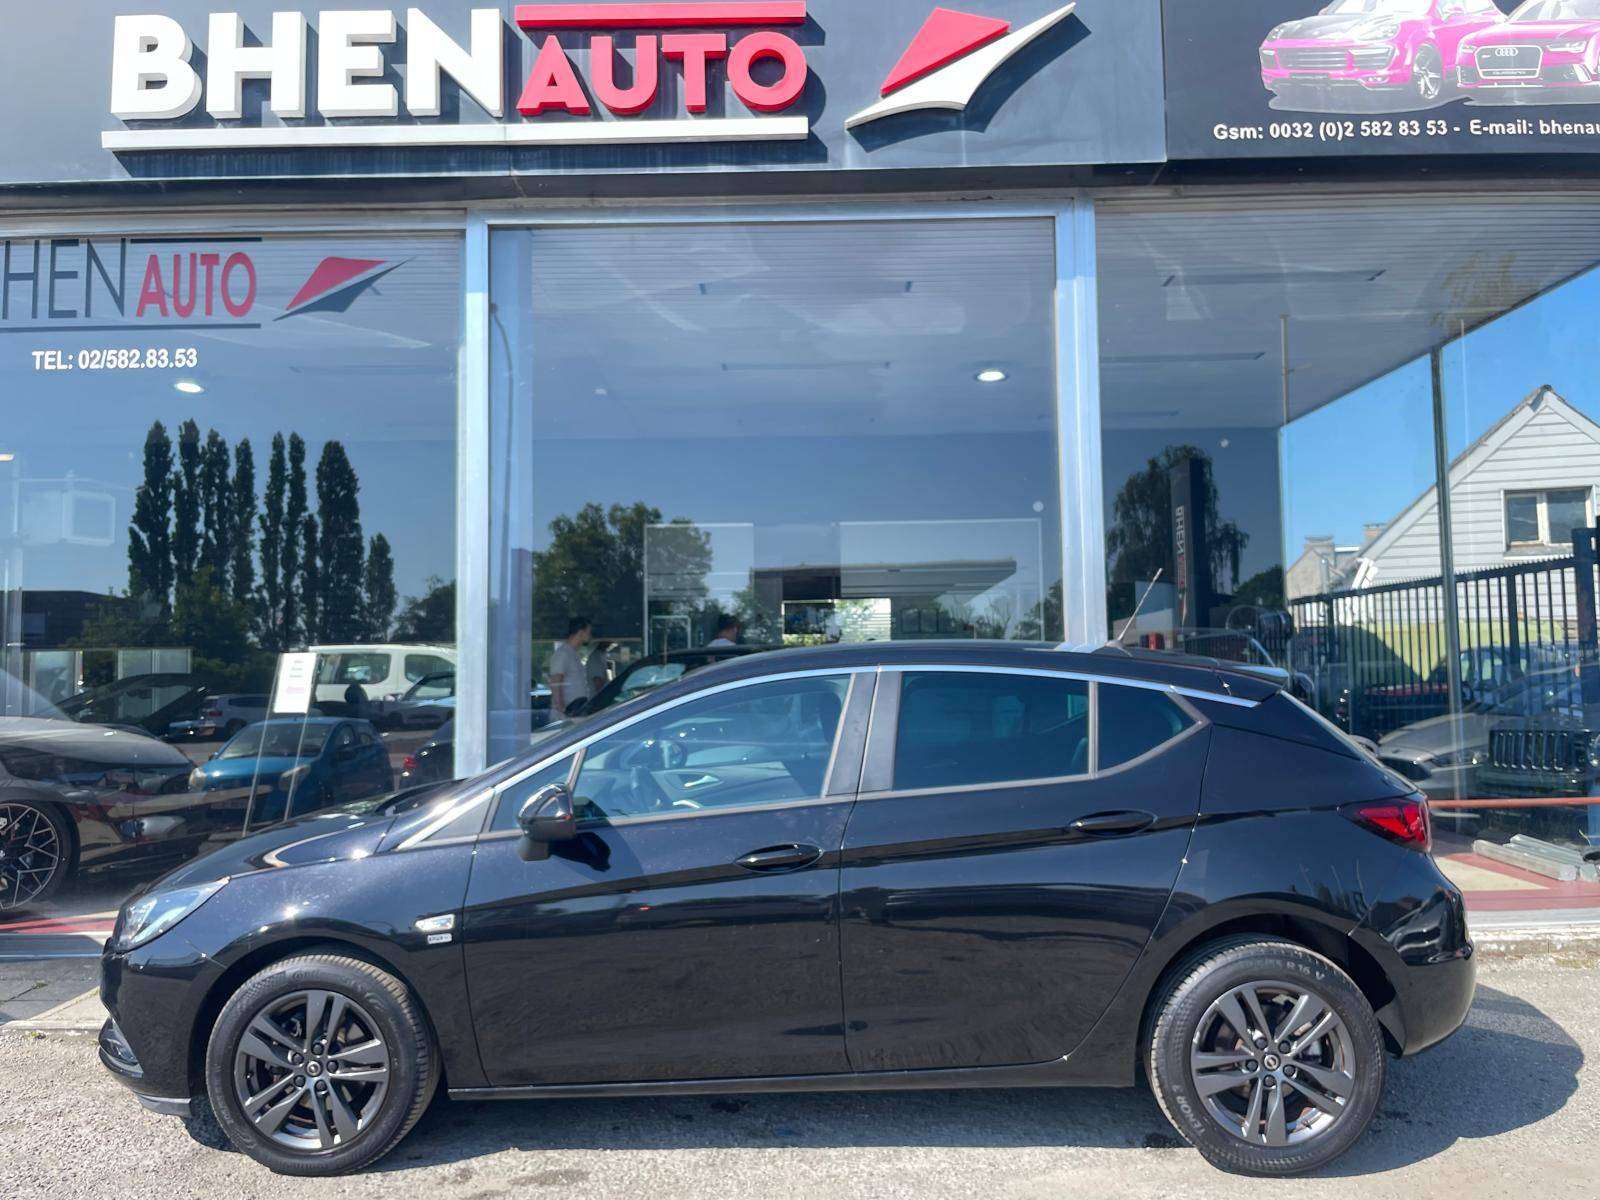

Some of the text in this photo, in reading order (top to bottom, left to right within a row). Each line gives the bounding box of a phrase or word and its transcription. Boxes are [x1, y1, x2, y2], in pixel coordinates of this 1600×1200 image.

[1213, 123, 1264, 140] Gsm:
[1269, 122, 1314, 138] 0032
[1319, 121, 1355, 142] (0)2
[1360, 120, 1393, 137] 582
[1398, 120, 1421, 136] 83
[1426, 119, 1448, 135] 53
[1469, 119, 1534, 135] E-mail:
[136, 252, 256, 318] AUTO
[31, 348, 198, 370] TEL: 02/582.83.53
